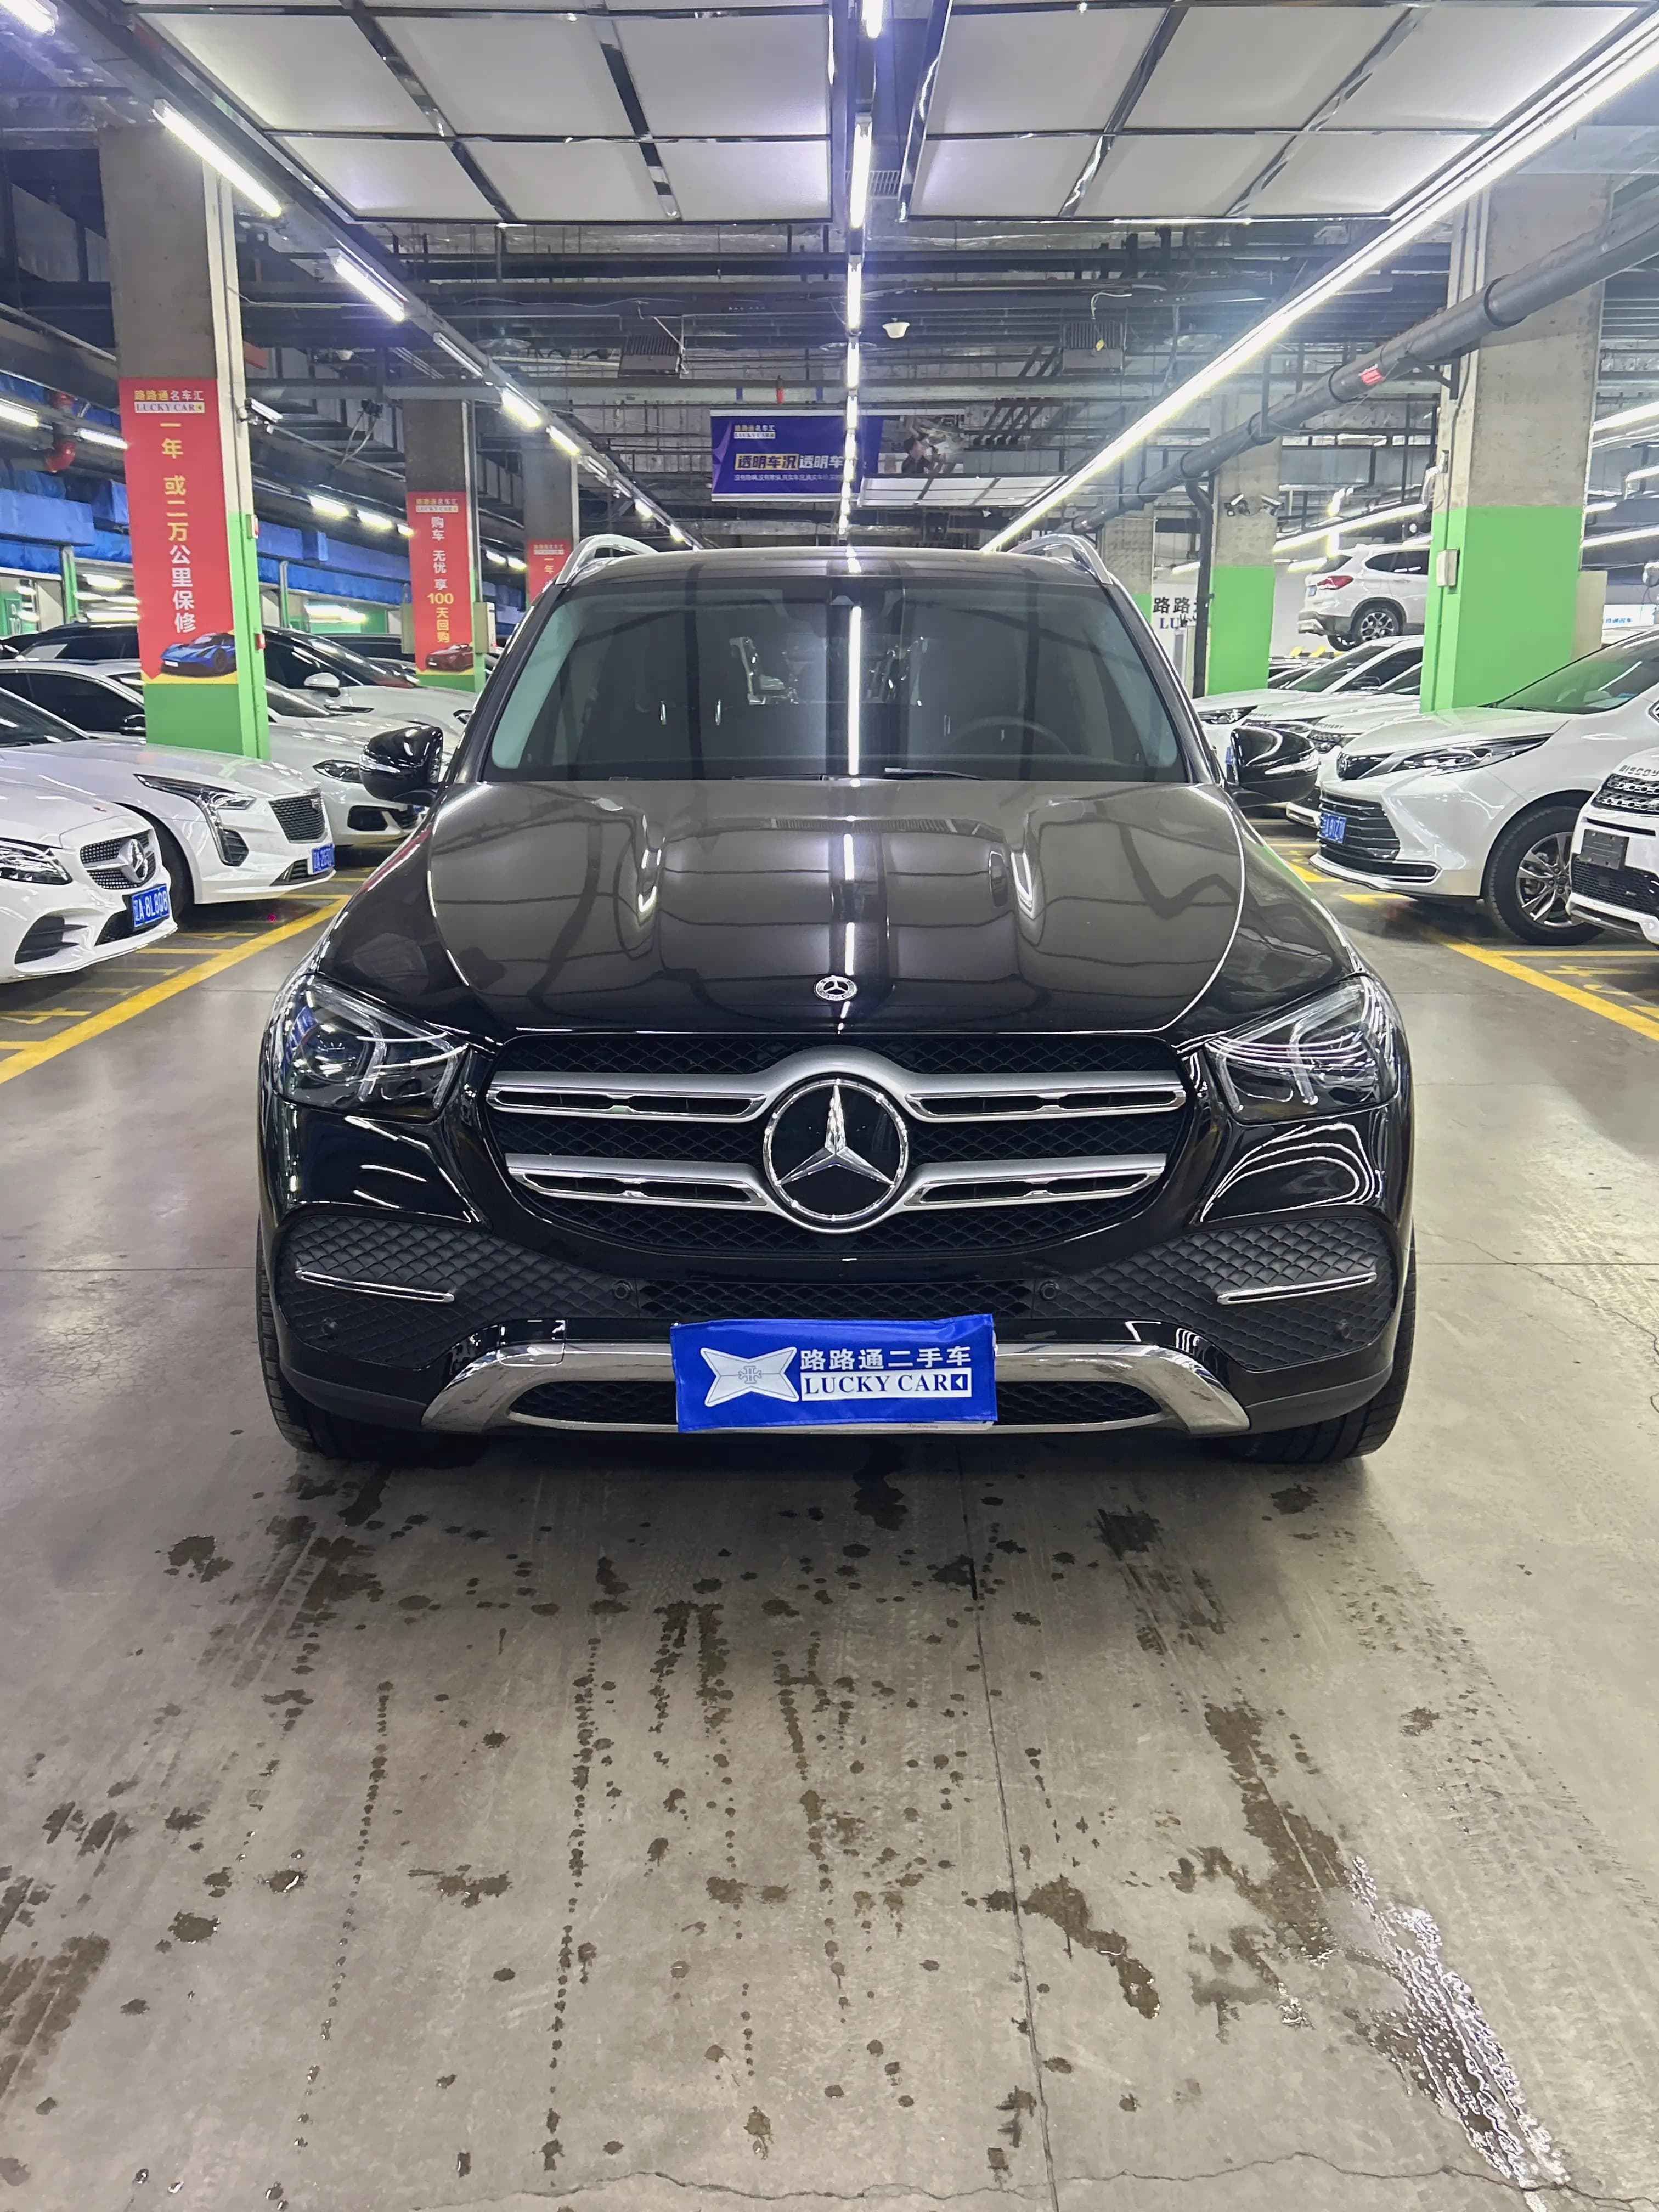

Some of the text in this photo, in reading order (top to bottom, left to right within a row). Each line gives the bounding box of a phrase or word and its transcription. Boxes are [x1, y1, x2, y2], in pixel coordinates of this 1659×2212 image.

[137, 403, 195, 411] LUCKY CAR
[1153, 596, 1197, 614] 路路
[800, 1346, 972, 1370] 路路通二手车
[804, 1374, 949, 1395] LUCKY CAR
